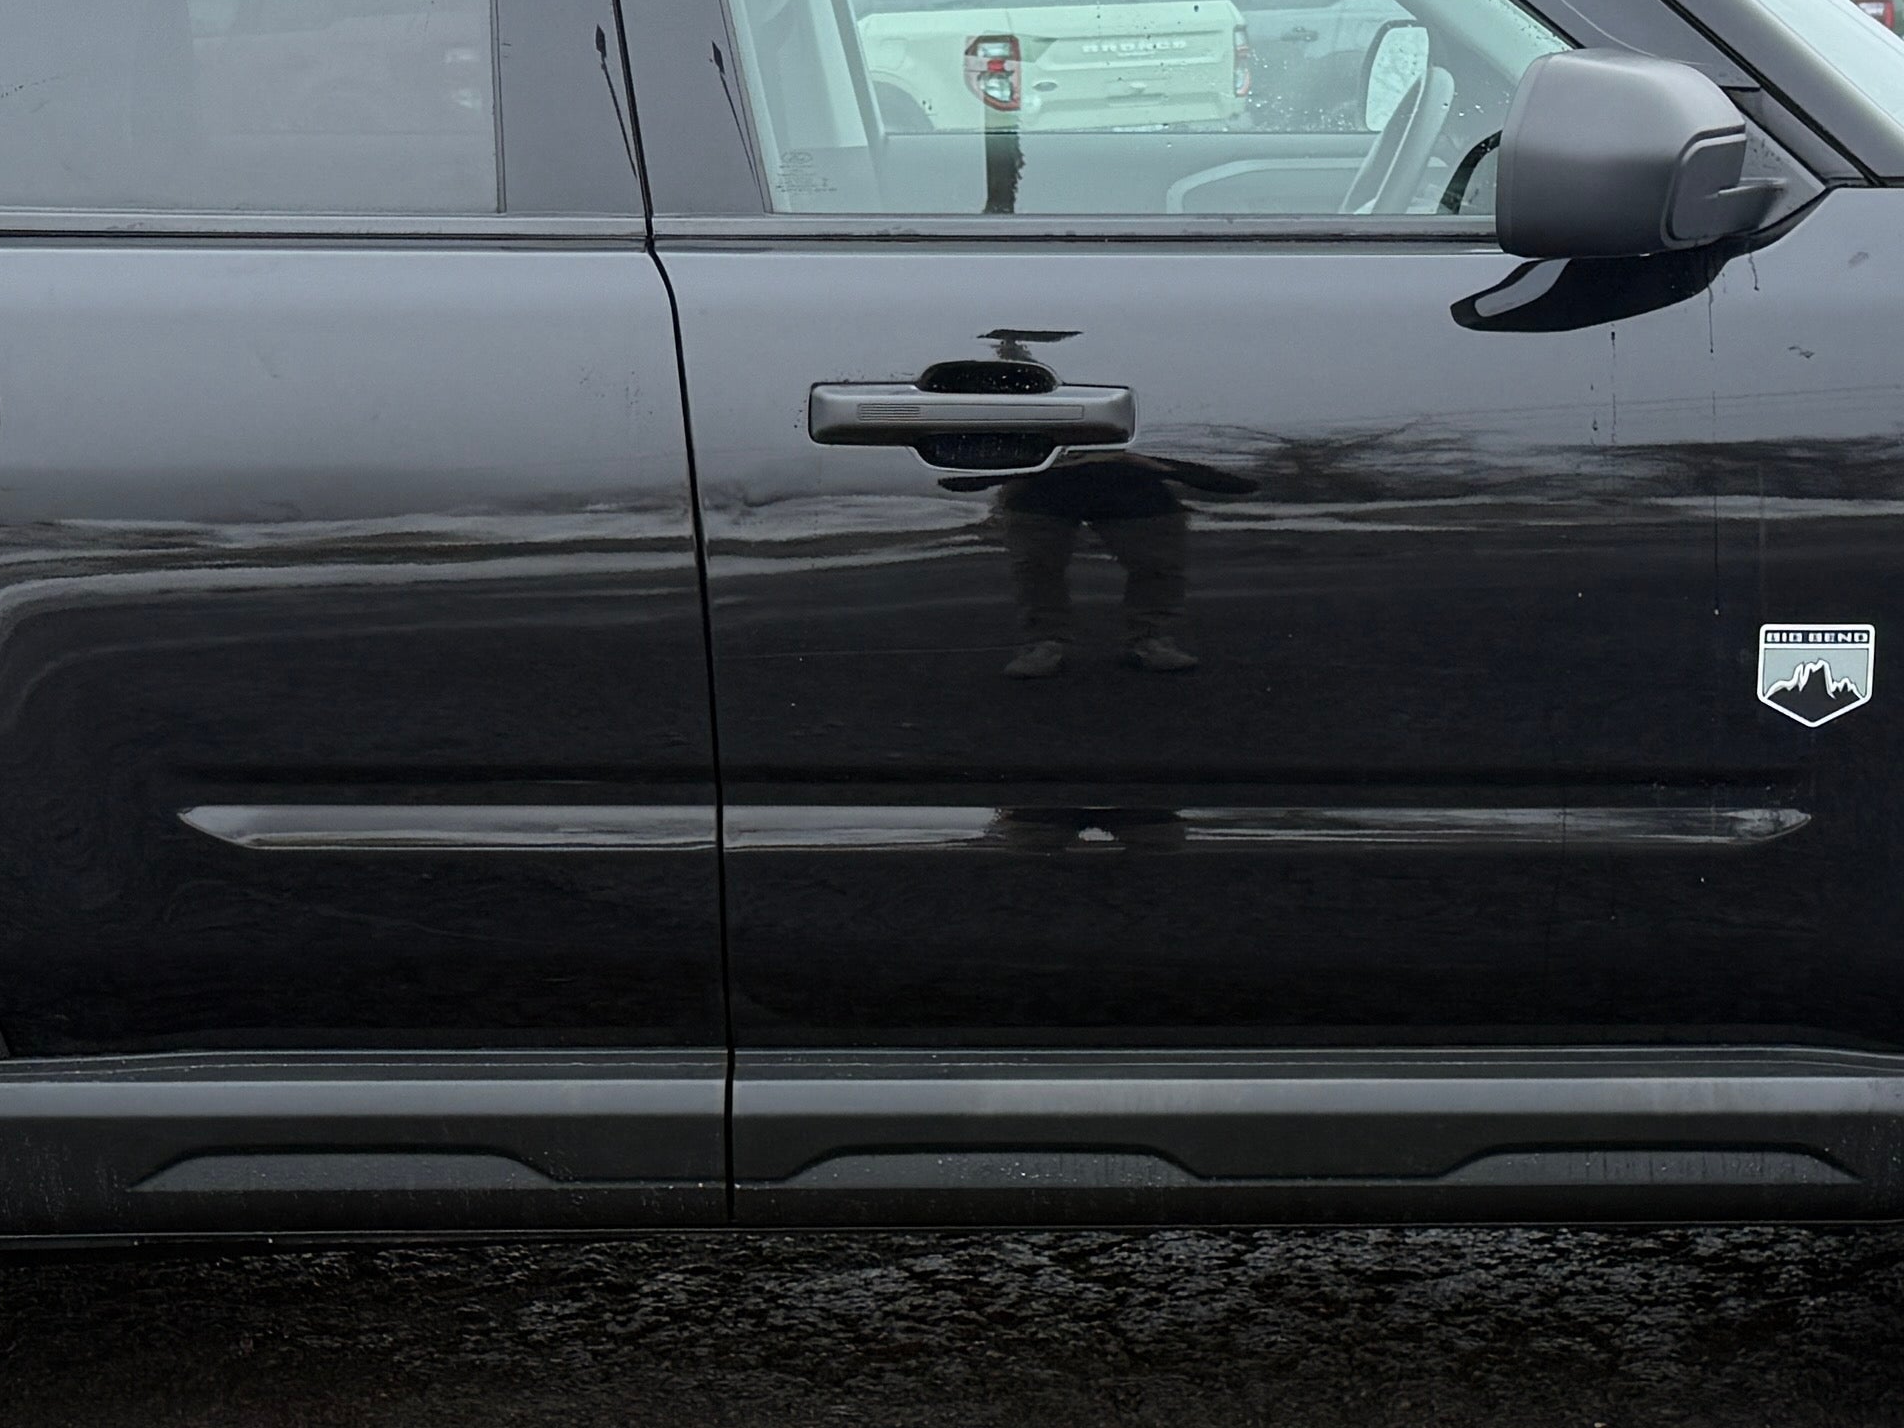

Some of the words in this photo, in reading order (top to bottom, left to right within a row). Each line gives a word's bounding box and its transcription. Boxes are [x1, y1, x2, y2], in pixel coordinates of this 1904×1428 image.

[1081, 40, 1187, 53] BRONCO
[1767, 632, 1803, 643] BIG
[1808, 632, 1869, 643] BEND
